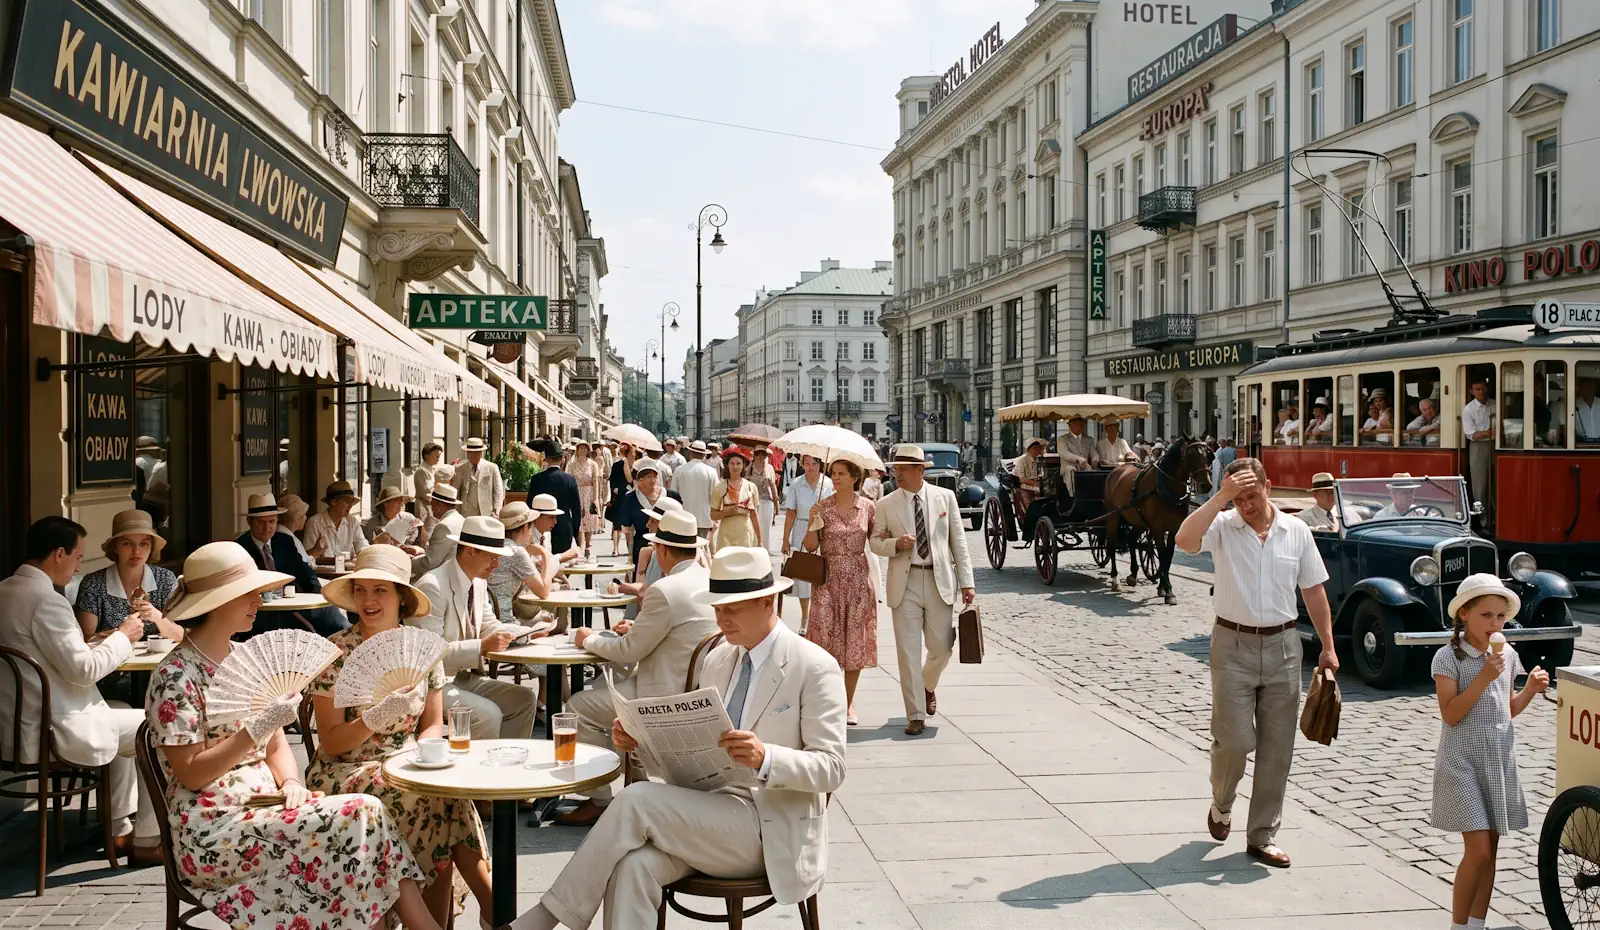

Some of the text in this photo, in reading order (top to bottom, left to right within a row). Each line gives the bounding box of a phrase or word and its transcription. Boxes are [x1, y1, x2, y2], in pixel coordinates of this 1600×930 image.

[1123, 2, 1198, 25] HOTEL
[929, 21, 1004, 109] BRISTOL HOTEL
[1131, 23, 1222, 98] RESTAURACJA
[54, 20, 326, 243] KAWIARNIA LWOWSKA
[1092, 234, 1103, 317] APTEKA
[1444, 240, 1600, 293] KINO POLO
[133, 285, 322, 364] LODY KAWA OBIADY
[416, 300, 541, 324] APTEKA
[1541, 303, 1559, 324] 18
[1569, 309, 1592, 321] PLAC
[367, 352, 386, 378] LODY
[1109, 352, 1180, 375] RESTAURACJA
[88, 393, 126, 420] KAWA
[246, 408, 267, 427] KAWA
[85, 436, 129, 461] OBIADY
[245, 438, 268, 457] OBIADY
[638, 698, 713, 715] GAZETA POLSKA
